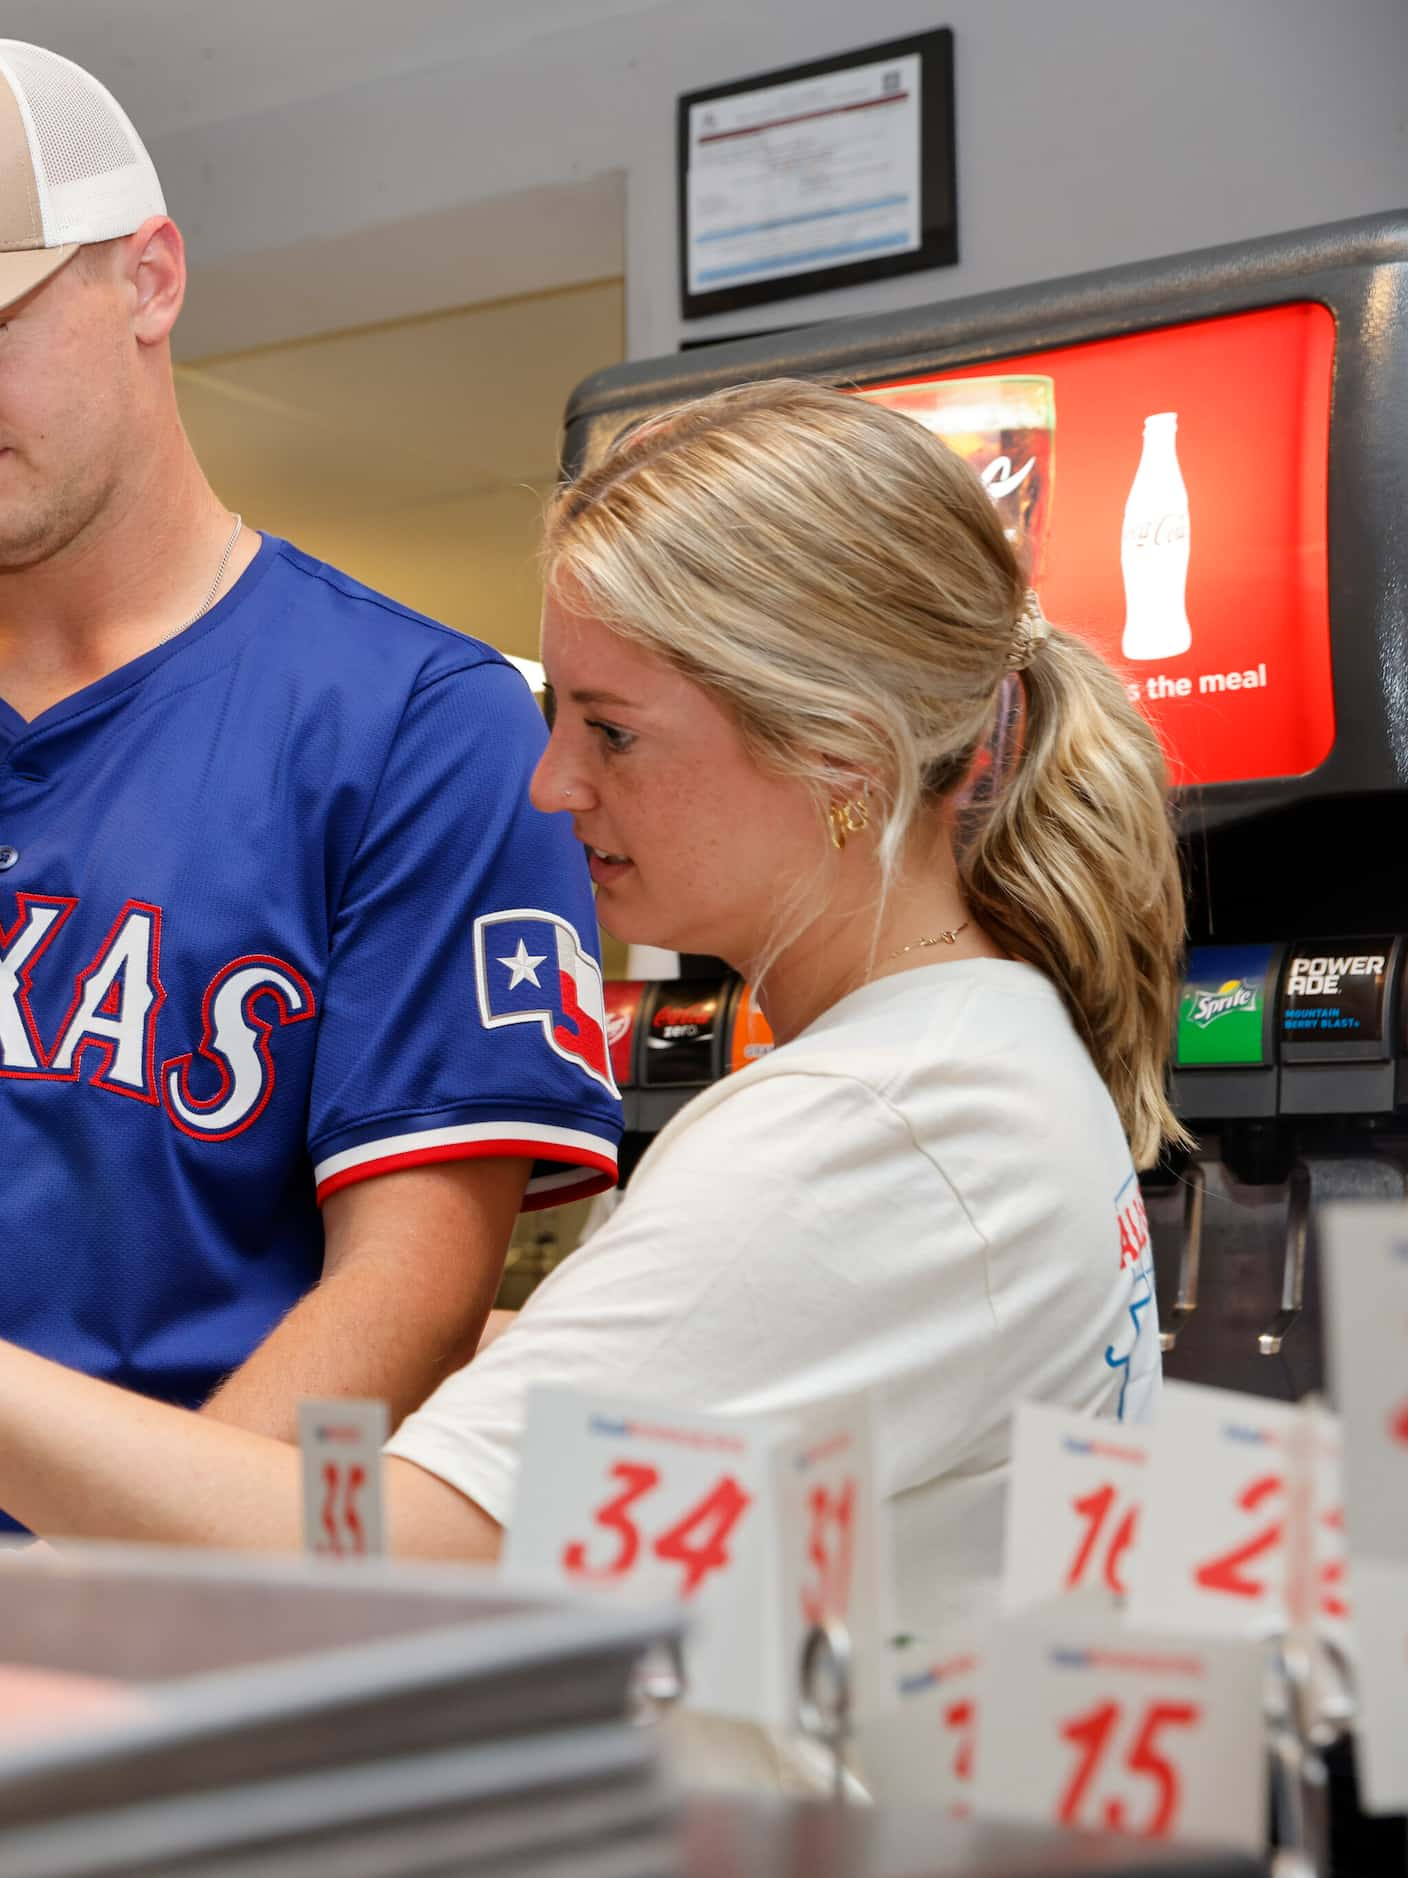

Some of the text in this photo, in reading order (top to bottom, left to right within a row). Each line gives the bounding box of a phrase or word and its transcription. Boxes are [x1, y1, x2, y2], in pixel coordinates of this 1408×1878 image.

[1148, 675, 1191, 702] the
[1199, 664, 1267, 695] meal
[1291, 956, 1385, 977] POWER
[1194, 989, 1251, 1021] Sprite
[1284, 1008, 1340, 1018] MOUNTAIN
[663, 1024, 699, 1038] zero
[1284, 1020, 1317, 1029] BERRY
[562, 1459, 752, 1604] 34
[1057, 1701, 1202, 1839] 15
